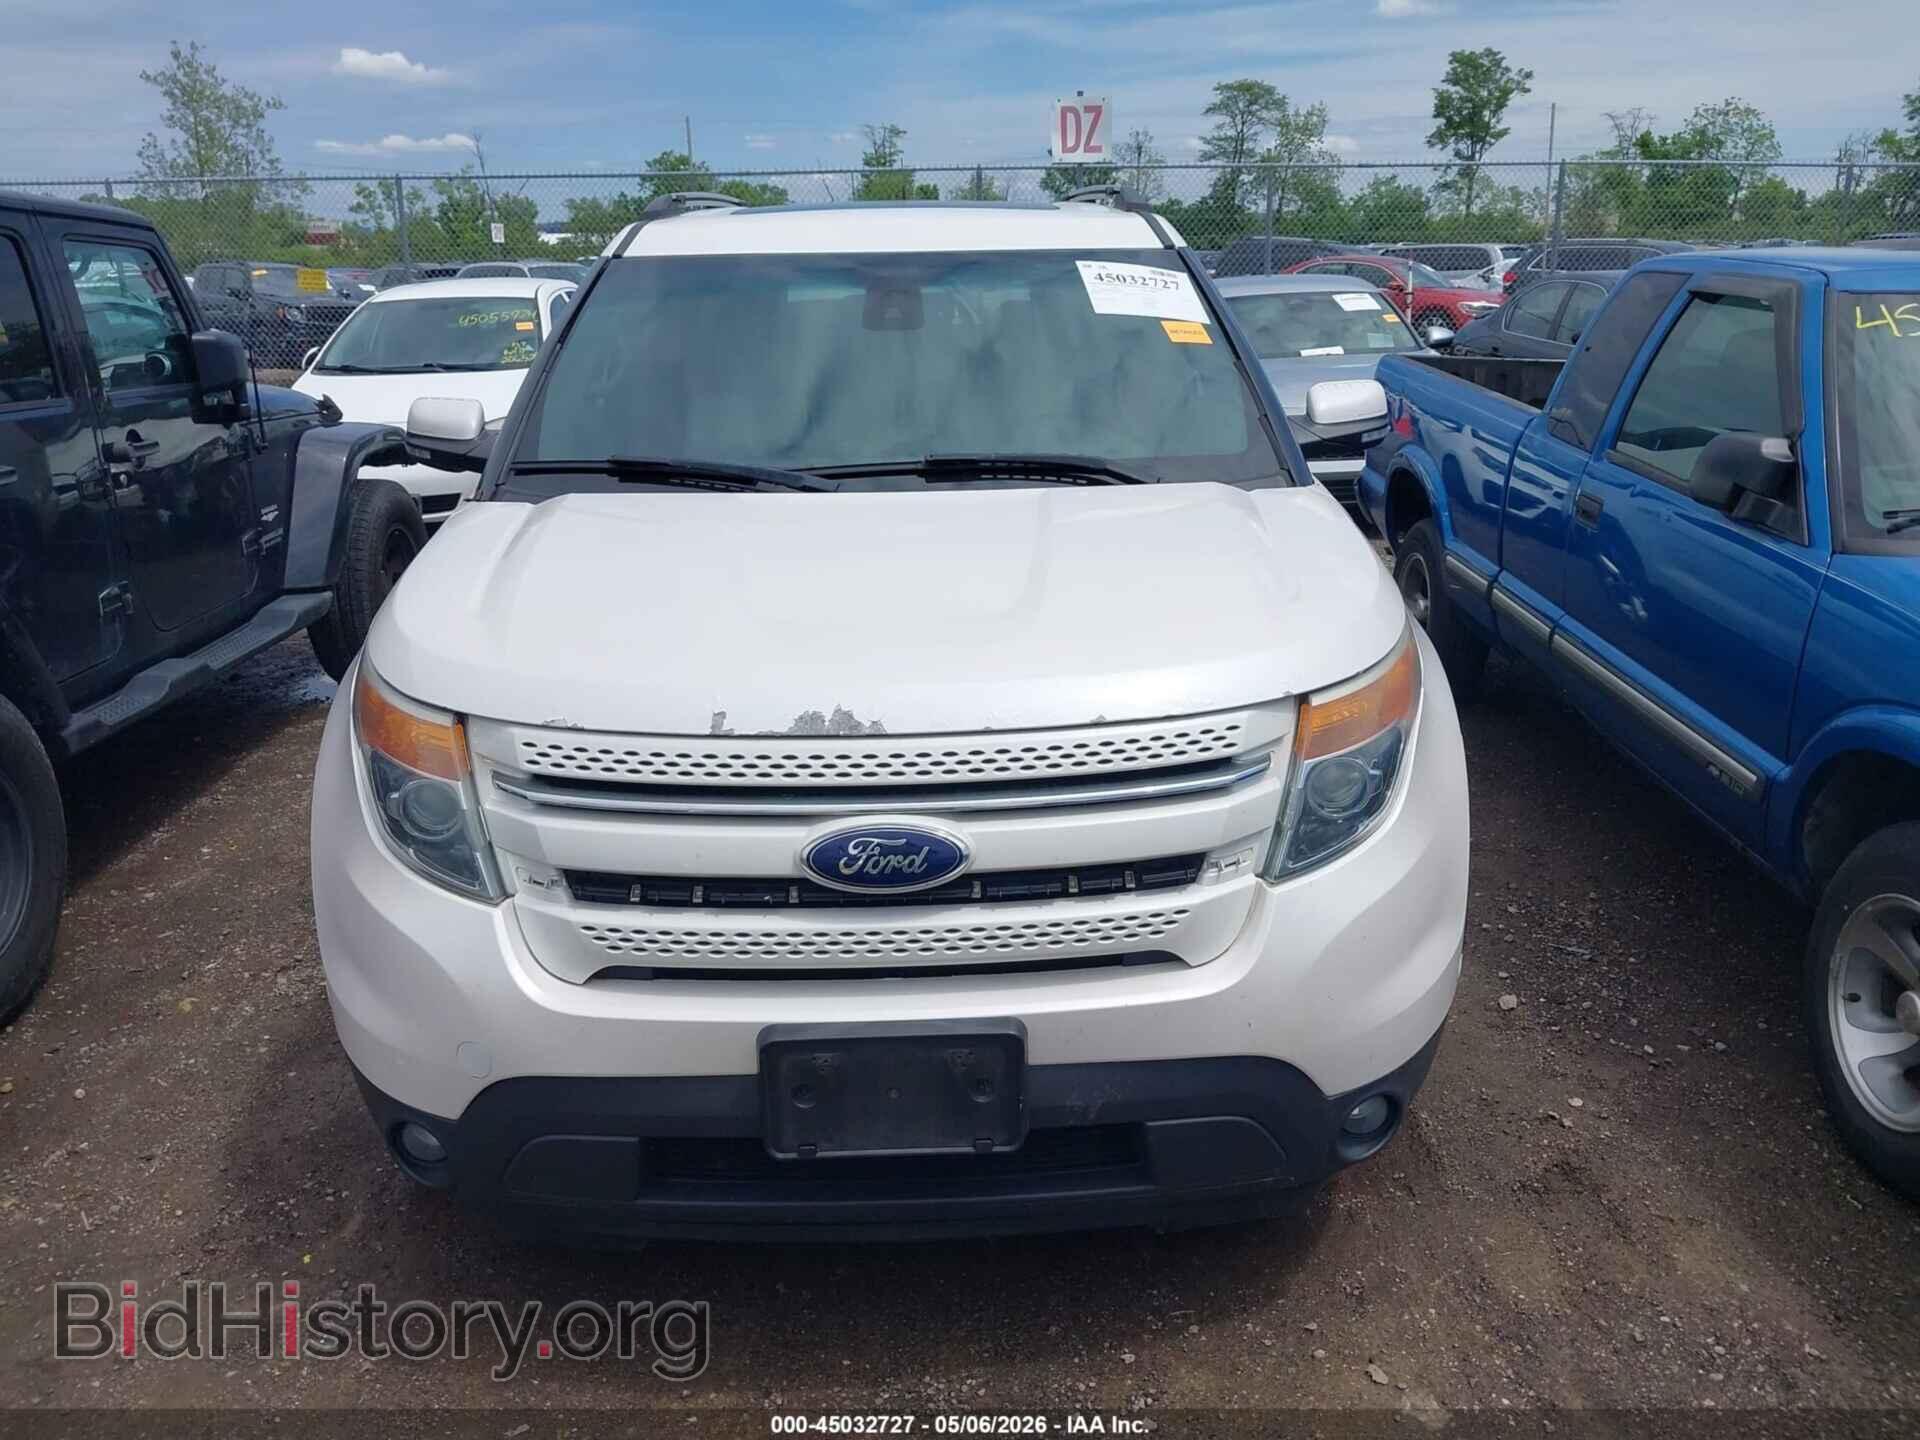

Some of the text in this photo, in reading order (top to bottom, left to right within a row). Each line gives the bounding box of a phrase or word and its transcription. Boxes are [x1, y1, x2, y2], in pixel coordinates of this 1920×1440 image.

[1060, 105, 1103, 153] DZ
[1093, 271, 1181, 291] 45032727
[838, 837, 930, 875] Ford
